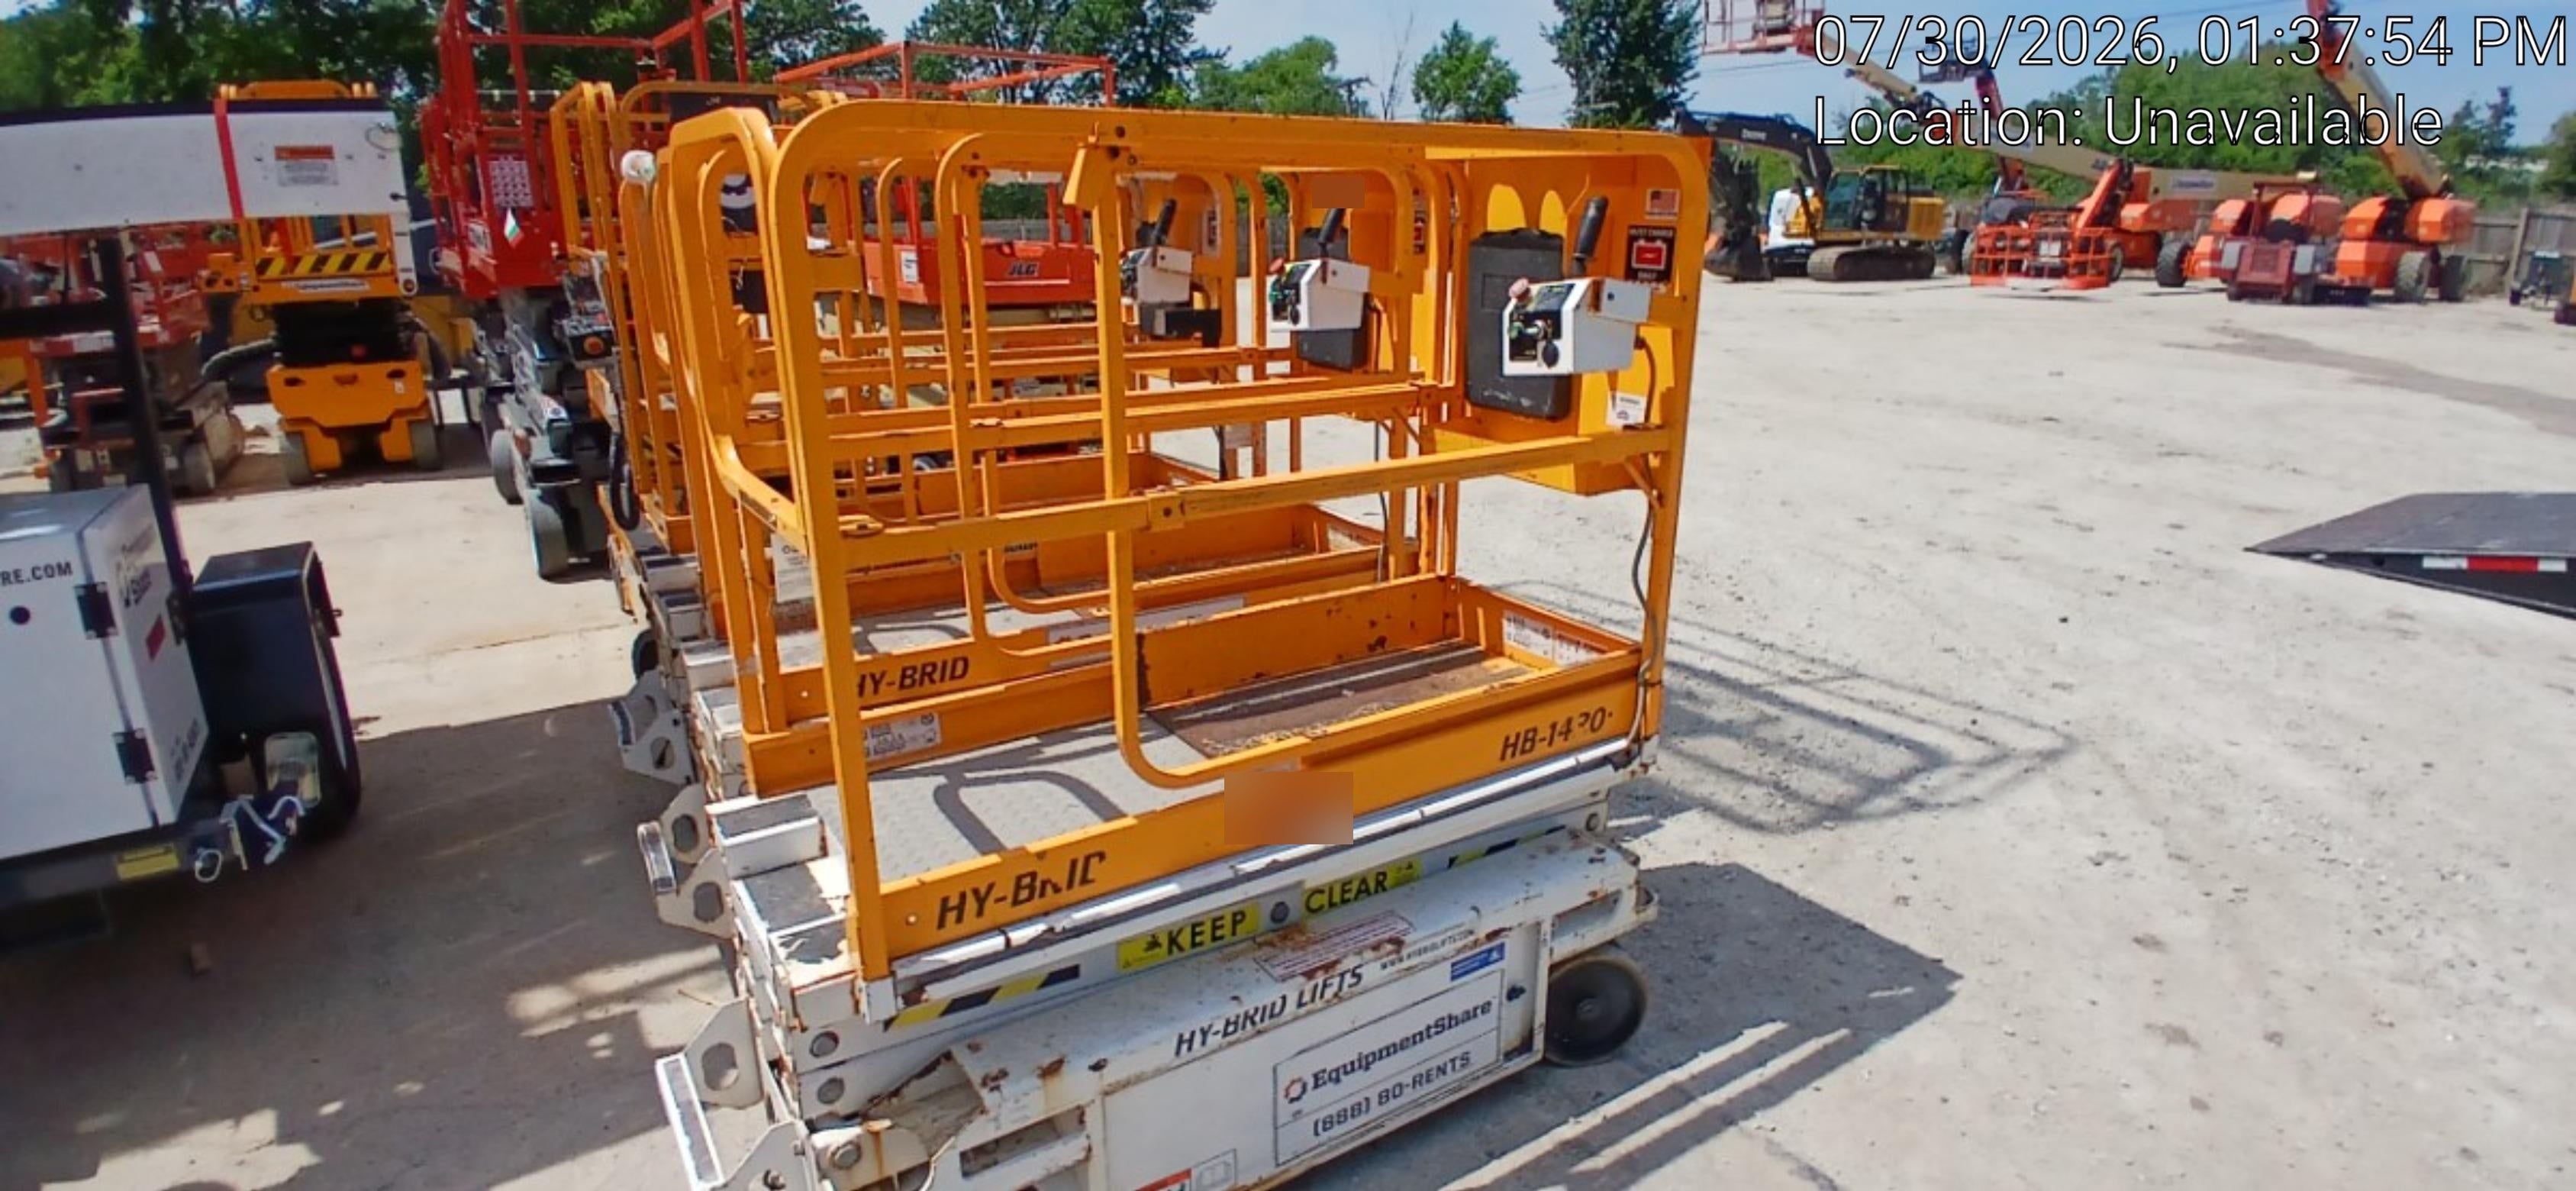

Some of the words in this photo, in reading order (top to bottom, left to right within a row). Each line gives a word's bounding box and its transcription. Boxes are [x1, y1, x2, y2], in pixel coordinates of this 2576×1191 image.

[1008, 261, 1038, 276] JLG
[1167, 911, 1246, 957] KEEP
[1305, 871, 1387, 914] CLEAR
[1296, 963, 1364, 1010] LIFTS
[1311, 1000, 1492, 1090] EquipmentShare
[1313, 1097, 1370, 1136] (888)
